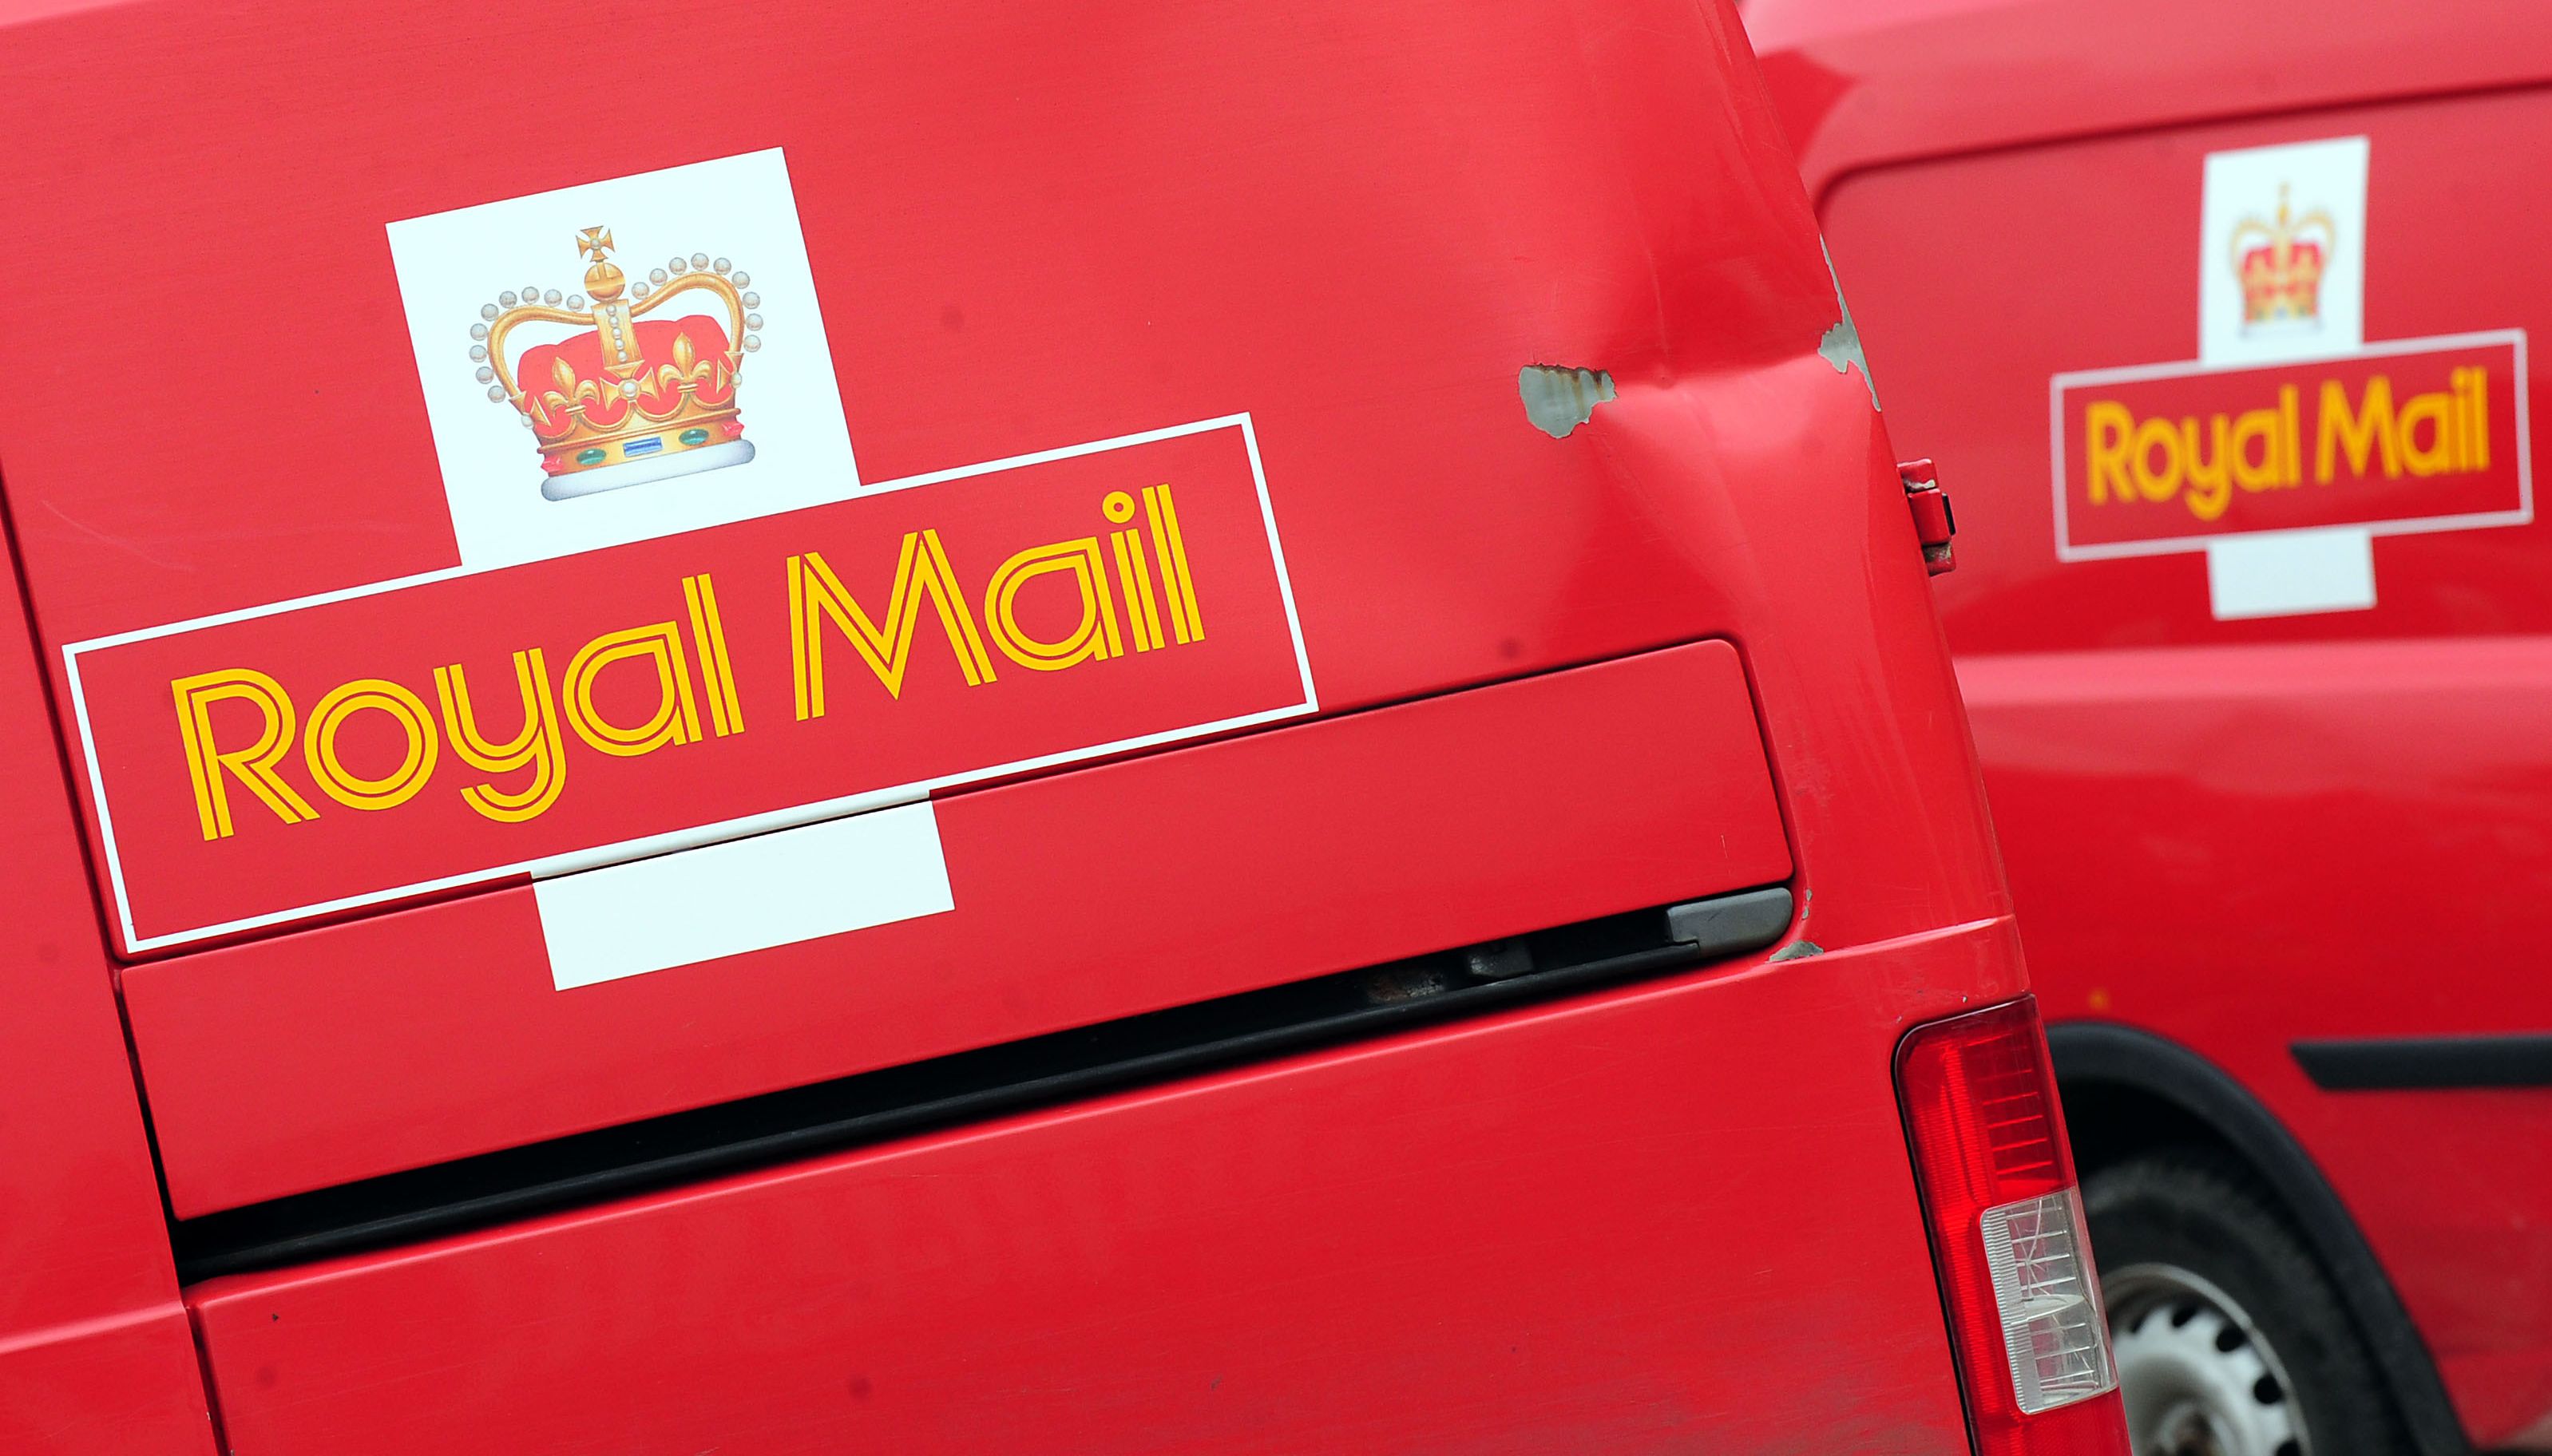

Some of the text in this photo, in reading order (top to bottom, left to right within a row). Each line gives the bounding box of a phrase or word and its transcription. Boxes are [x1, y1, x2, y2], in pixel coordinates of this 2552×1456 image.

[2085, 366, 2490, 520] Royal Mail
[171, 484, 1206, 841] Royal Mail
